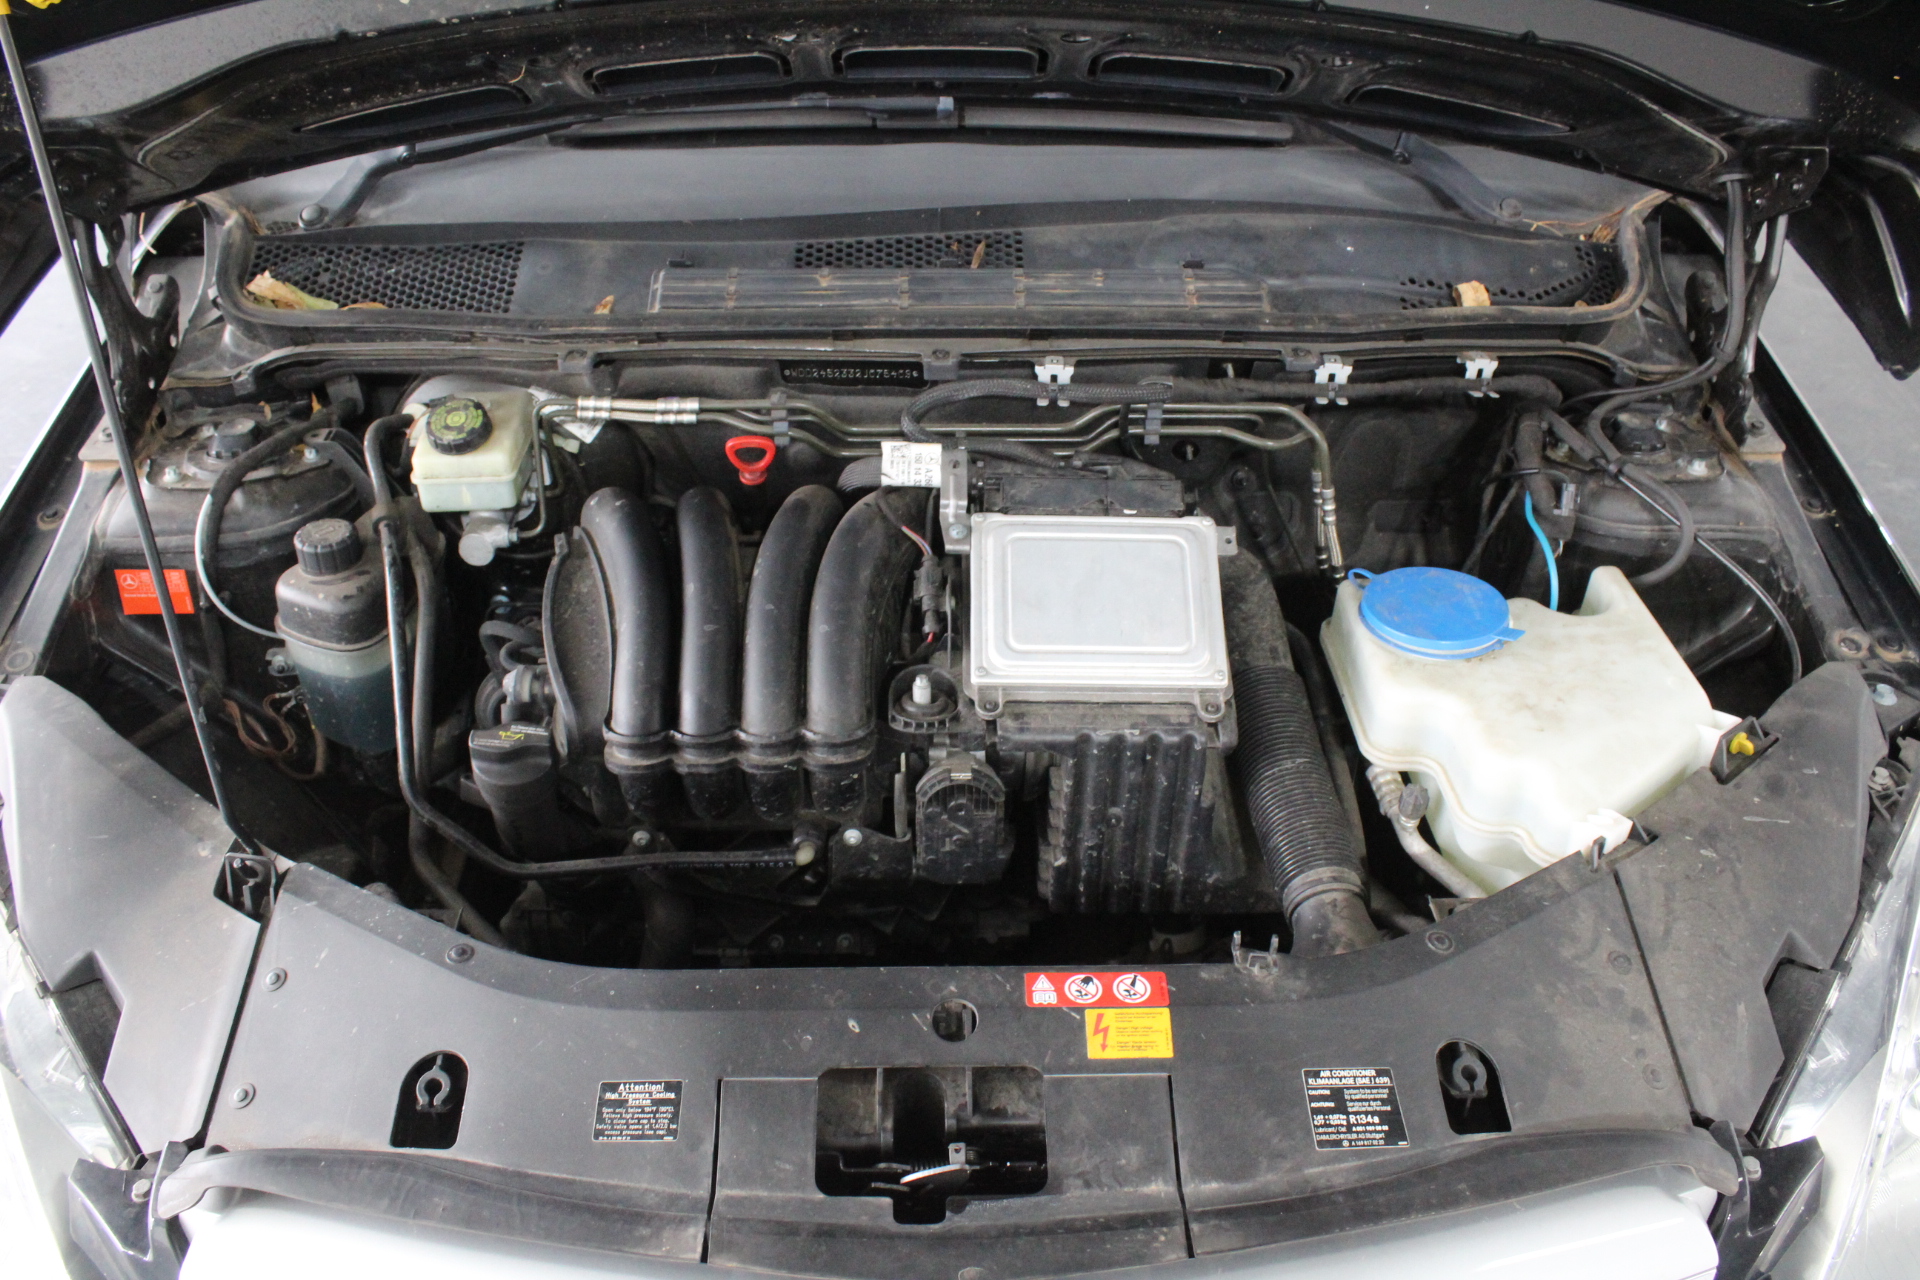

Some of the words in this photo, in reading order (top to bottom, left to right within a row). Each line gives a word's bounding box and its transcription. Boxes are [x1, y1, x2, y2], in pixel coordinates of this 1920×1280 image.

[1356, 1077, 1370, 1085] (SAE
[1375, 1077, 1390, 1085] 639)
[618, 1082, 664, 1091] Attention!
[1349, 1114, 1380, 1124] R134a
